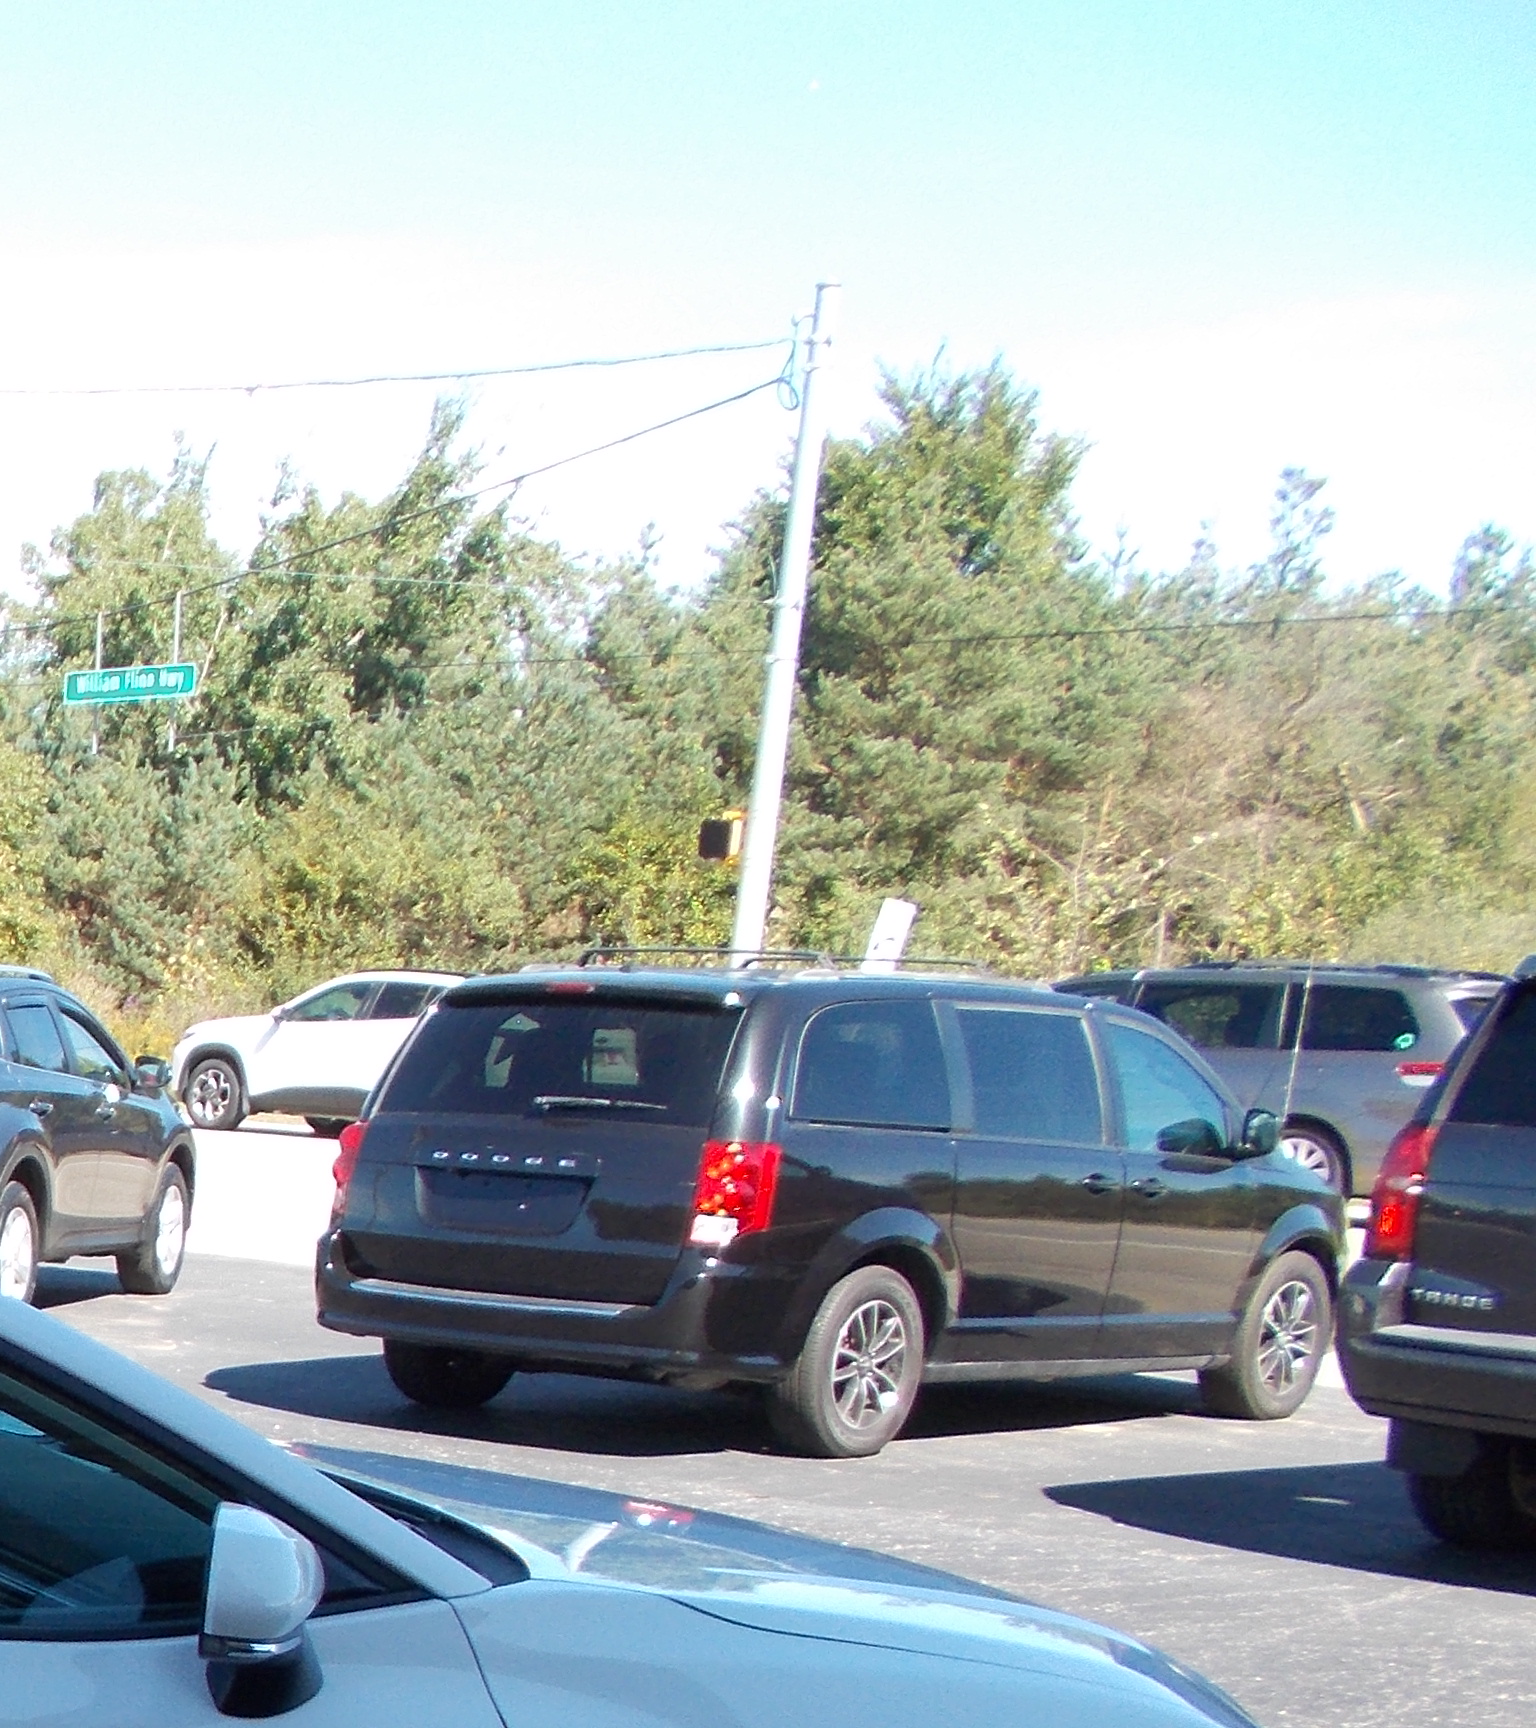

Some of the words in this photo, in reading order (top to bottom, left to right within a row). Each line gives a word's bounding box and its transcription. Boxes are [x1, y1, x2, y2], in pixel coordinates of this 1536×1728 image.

[76, 671, 120, 693] William
[159, 667, 184, 692] Hwy
[432, 1150, 575, 1168] DODGE
[1411, 1289, 1493, 1310] TAHOE
